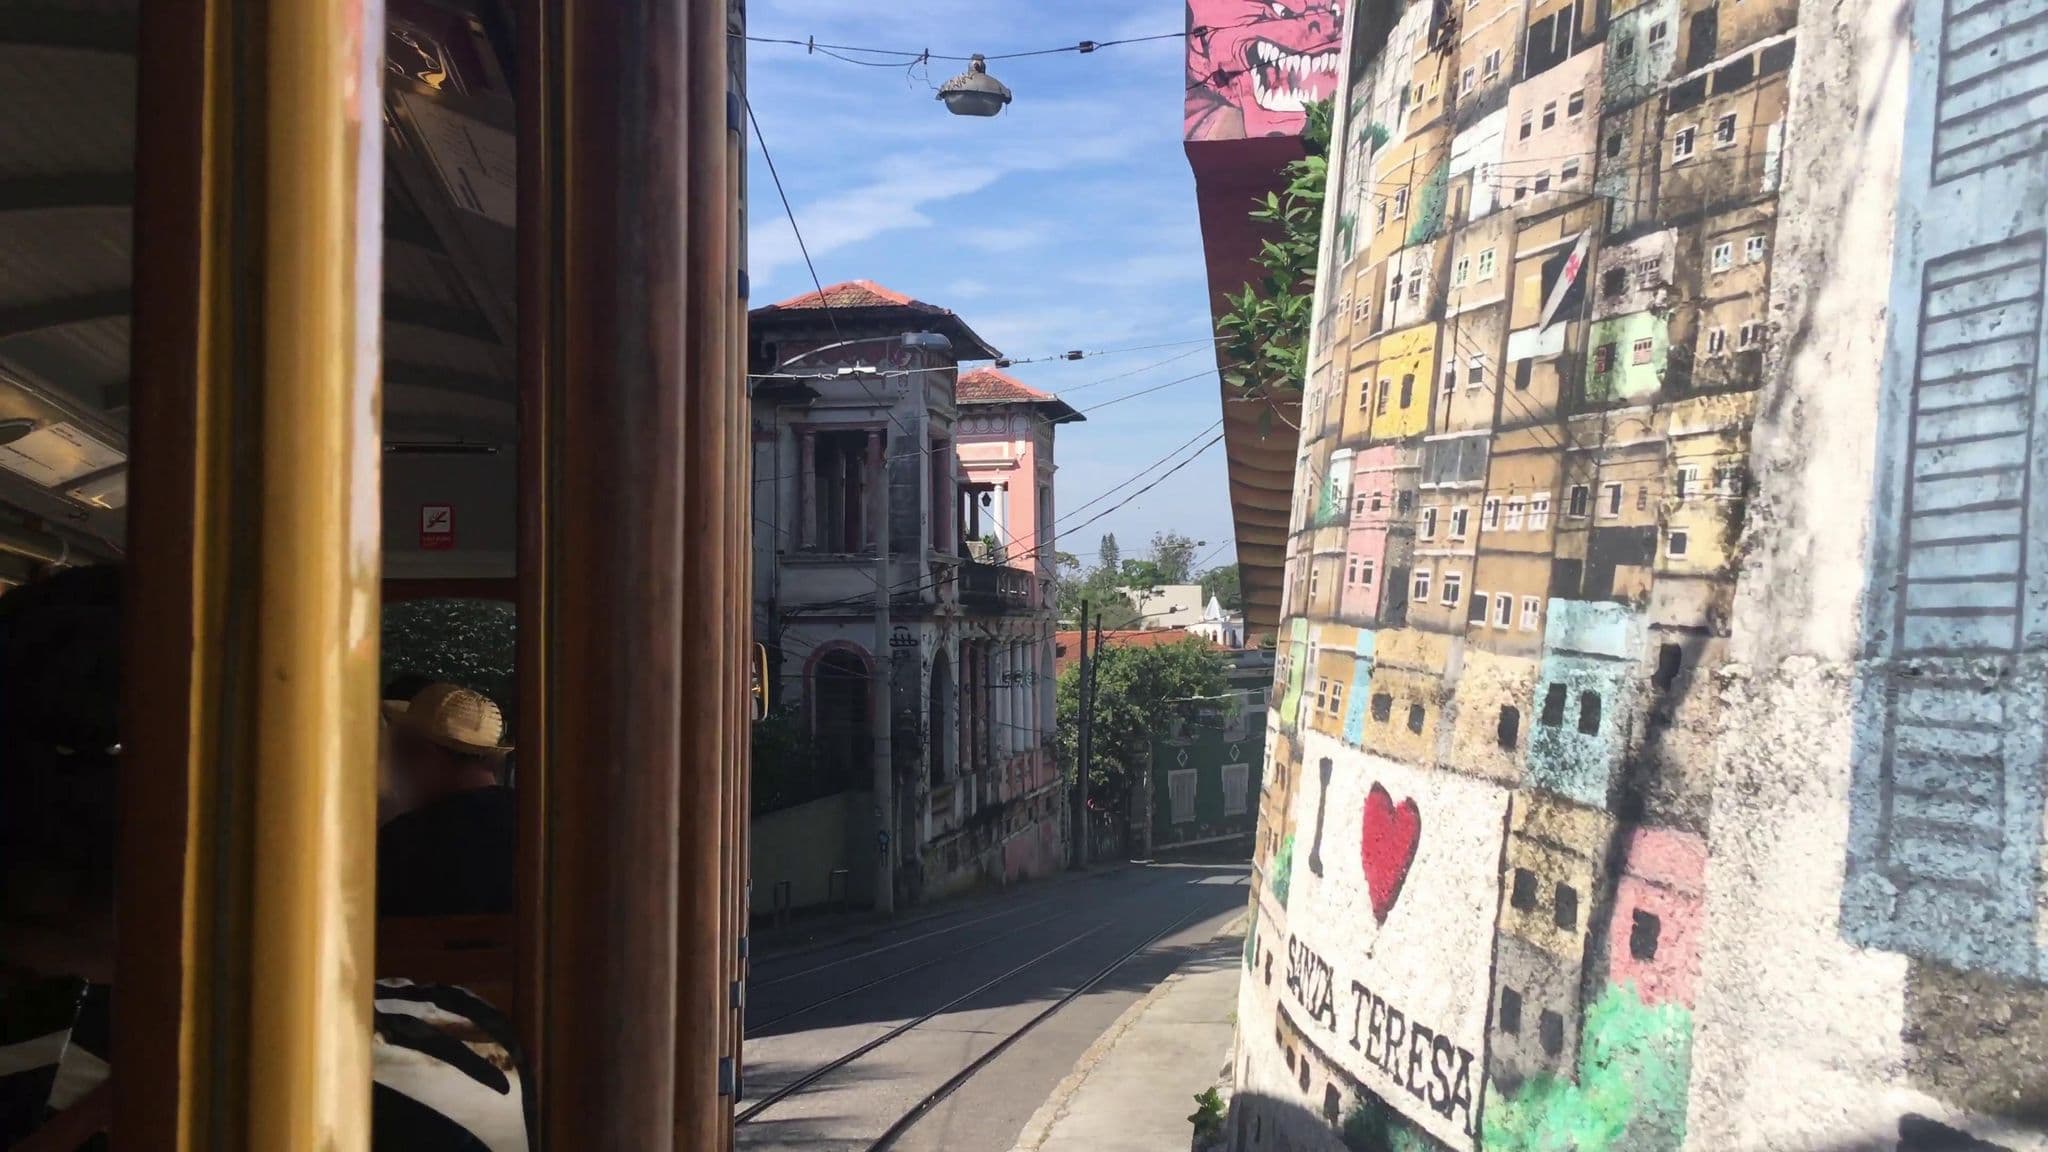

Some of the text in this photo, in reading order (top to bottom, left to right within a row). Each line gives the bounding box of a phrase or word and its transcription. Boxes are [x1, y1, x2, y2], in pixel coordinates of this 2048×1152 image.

[1308, 757, 1333, 878] I
[1287, 933, 1475, 1138] SANTA TERESA
